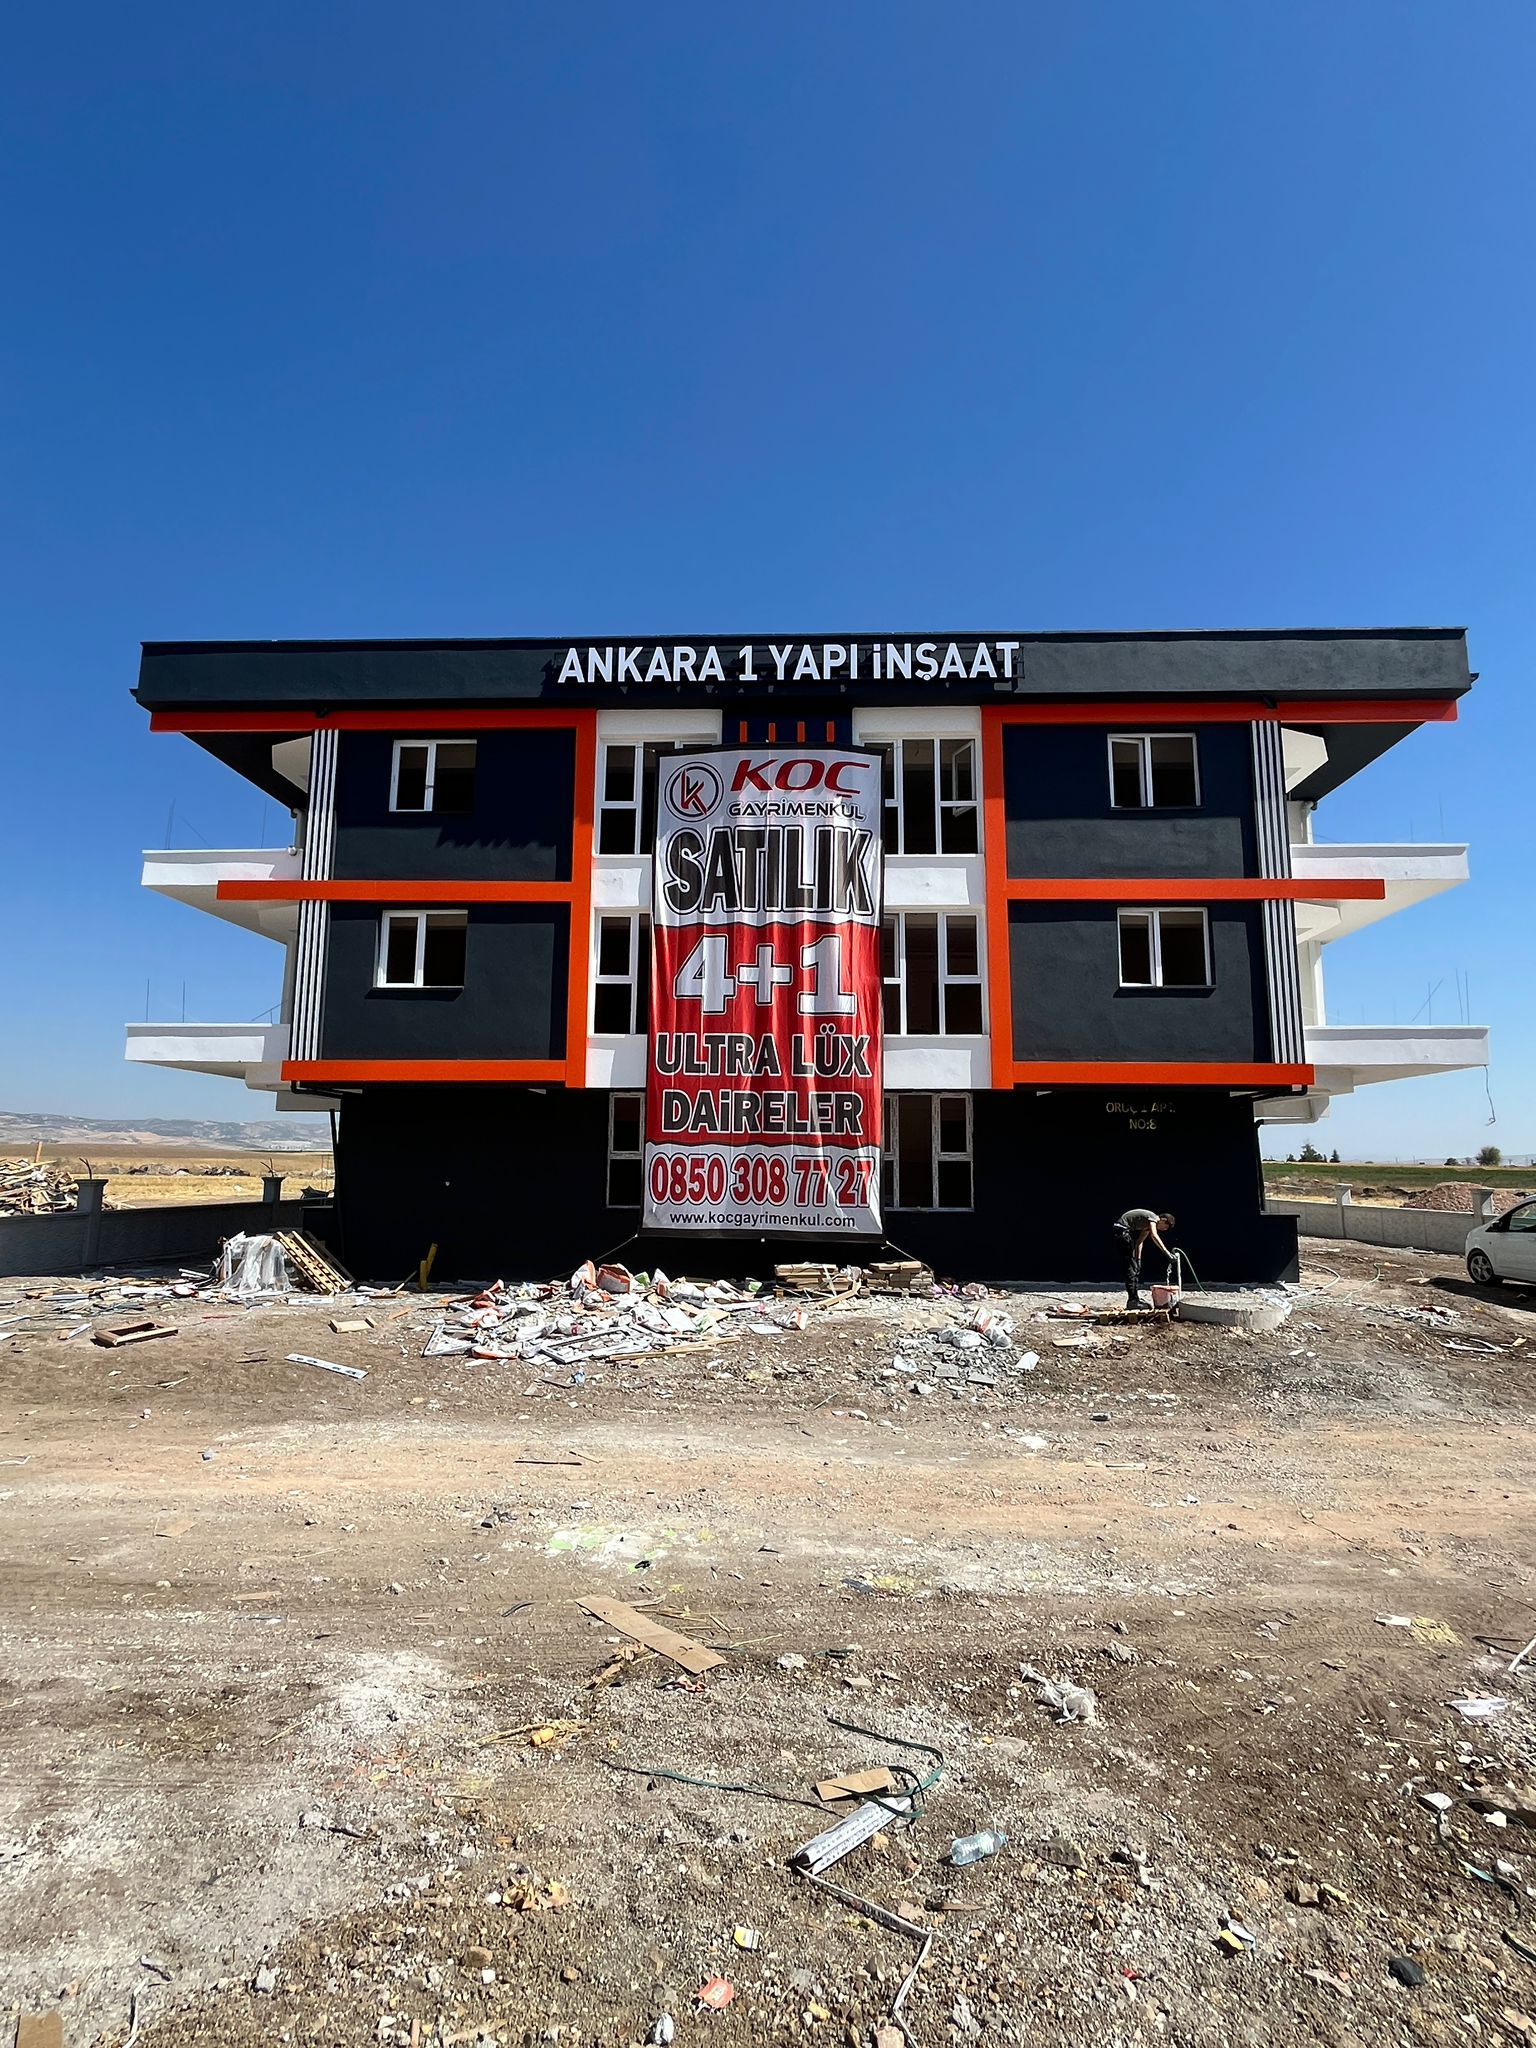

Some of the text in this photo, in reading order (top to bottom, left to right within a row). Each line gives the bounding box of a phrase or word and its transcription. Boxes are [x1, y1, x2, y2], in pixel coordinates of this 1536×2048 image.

[557, 645, 726, 683] ANKARA
[738, 645, 758, 682] 1
[768, 643, 858, 681] YAPI
[730, 758, 871, 799] KOÇ
[664, 825, 873, 916] SATILIK
[674, 933, 858, 1016] 4+1
[655, 1023, 873, 1078] ULTRA LÜX
[650, 1152, 876, 1208] 0850 308 77 27
[670, 1211, 856, 1228] www.kocgayrimenkul.com
